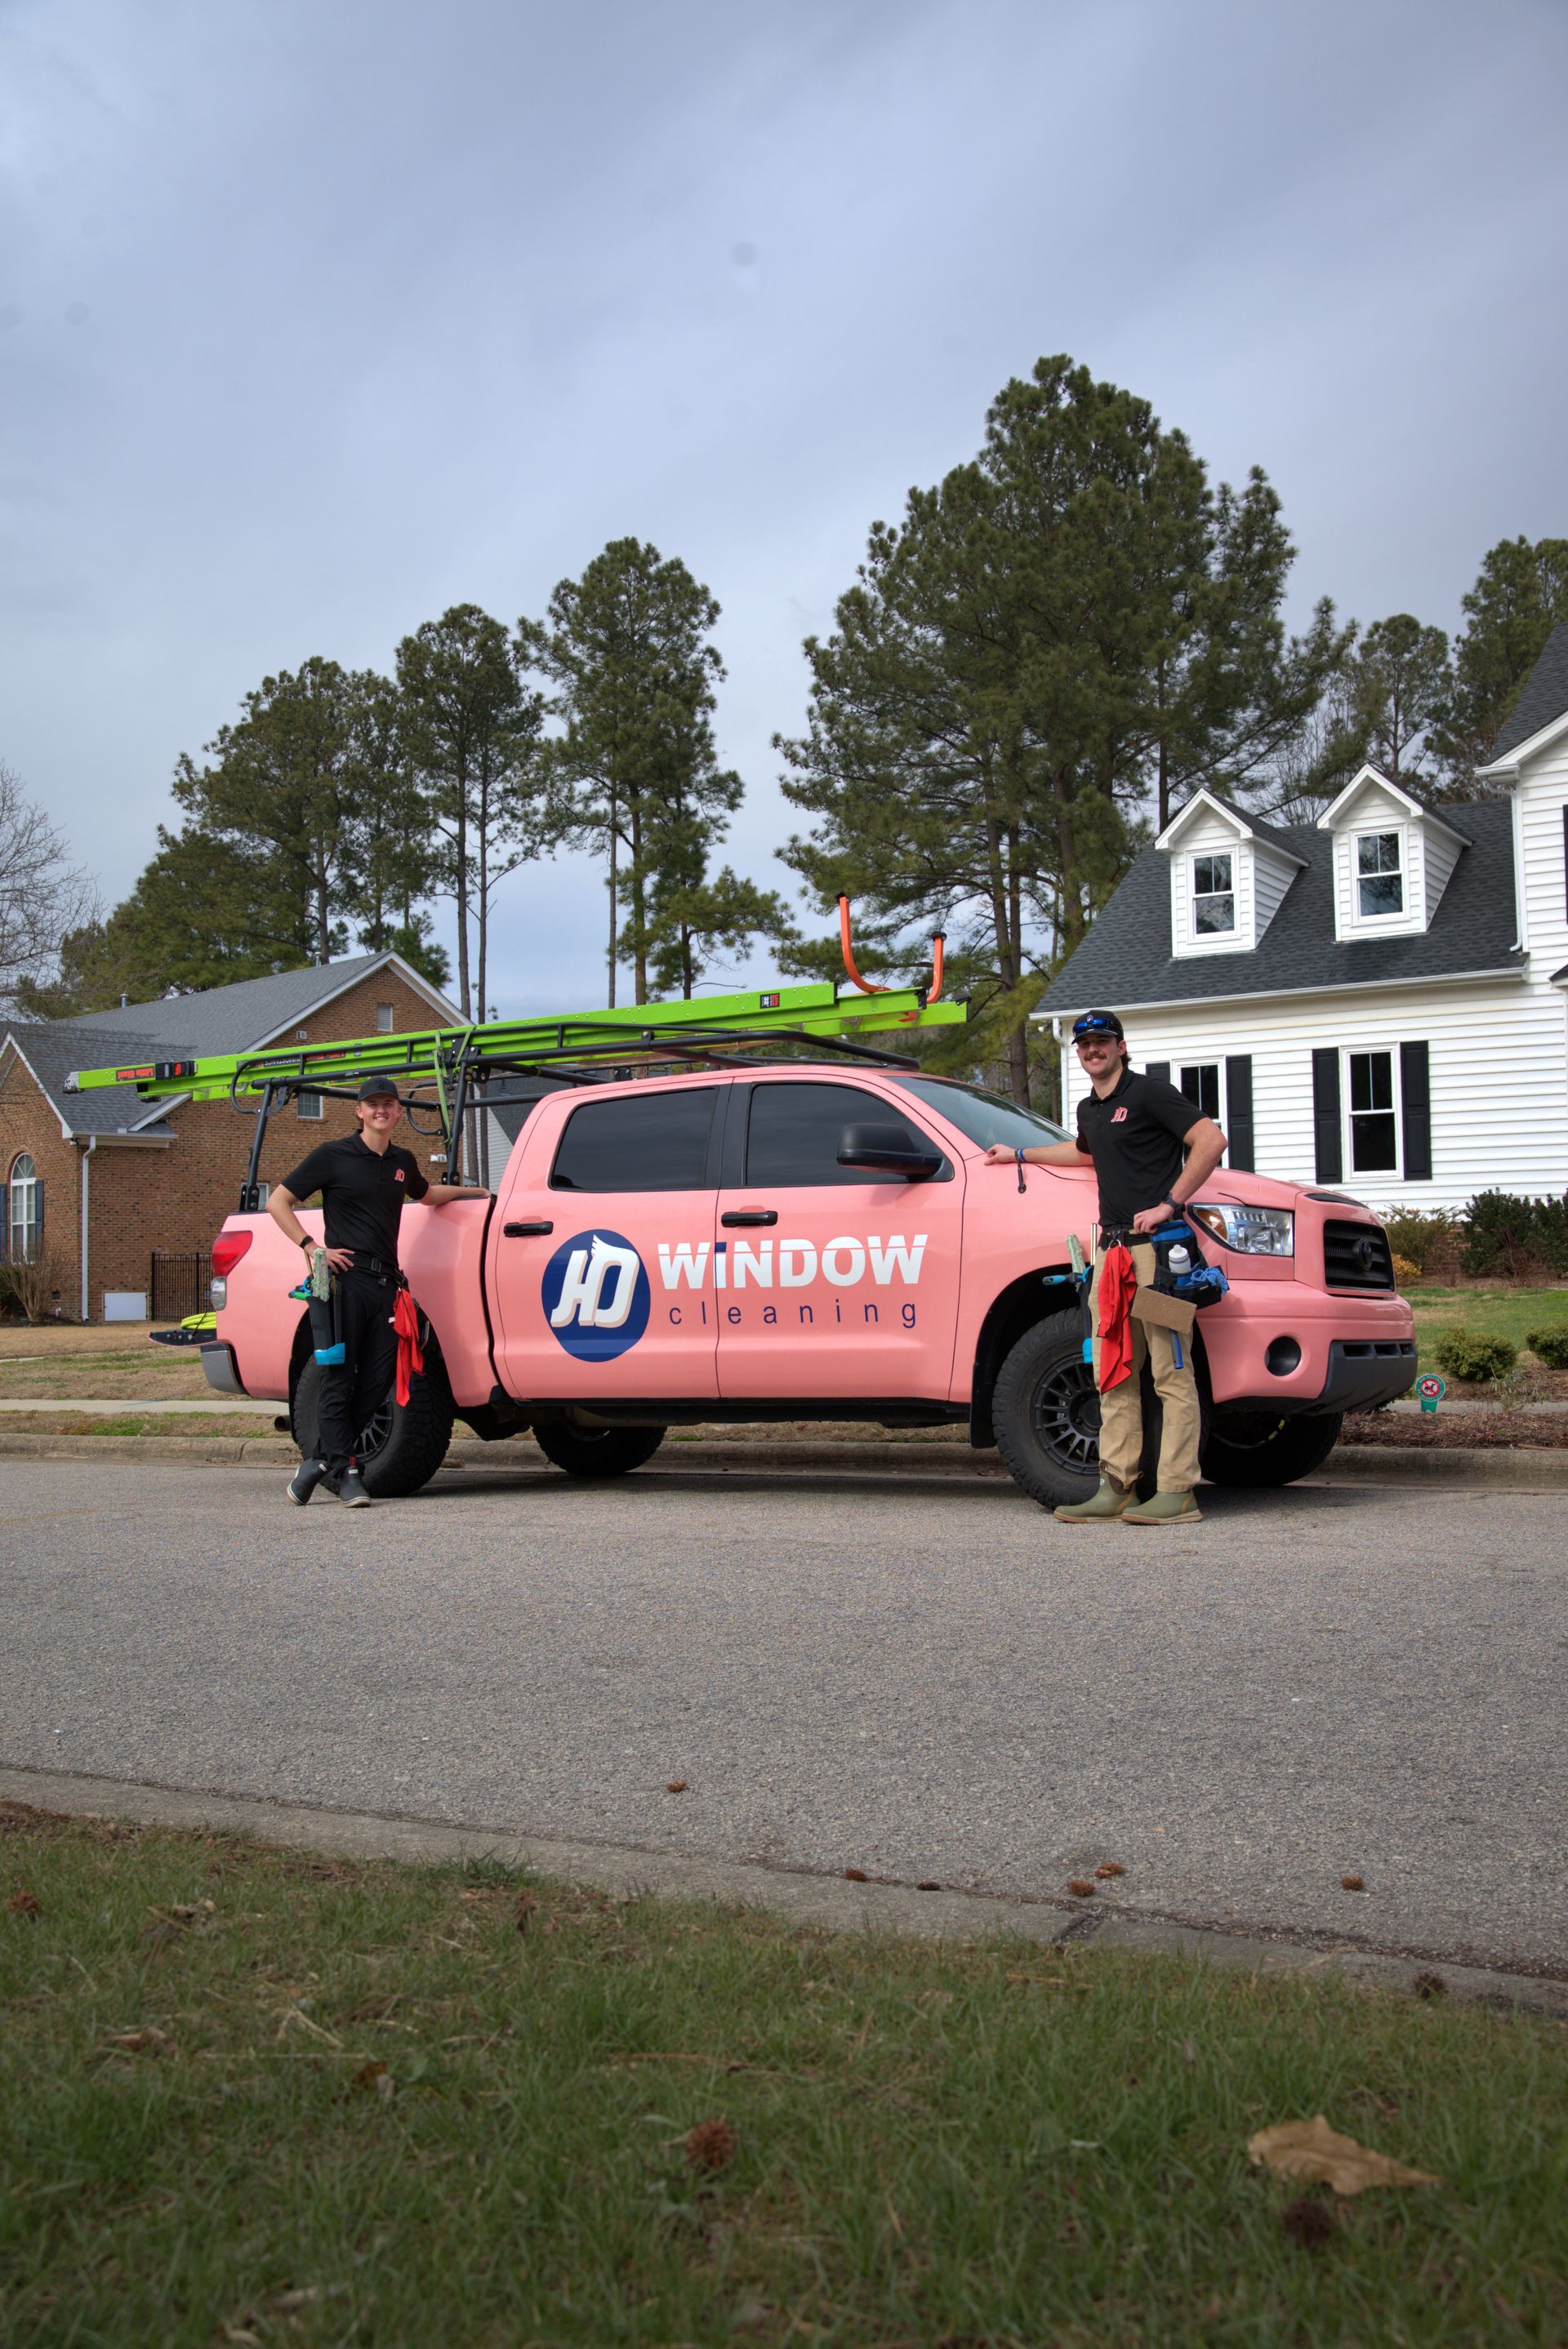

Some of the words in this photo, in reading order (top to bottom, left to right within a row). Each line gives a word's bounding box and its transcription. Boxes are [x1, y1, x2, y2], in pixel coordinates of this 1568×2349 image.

[117, 1069, 135, 1080] Giant
[136, 1067, 154, 1077] Little
[669, 1299, 916, 1328] cleaning
